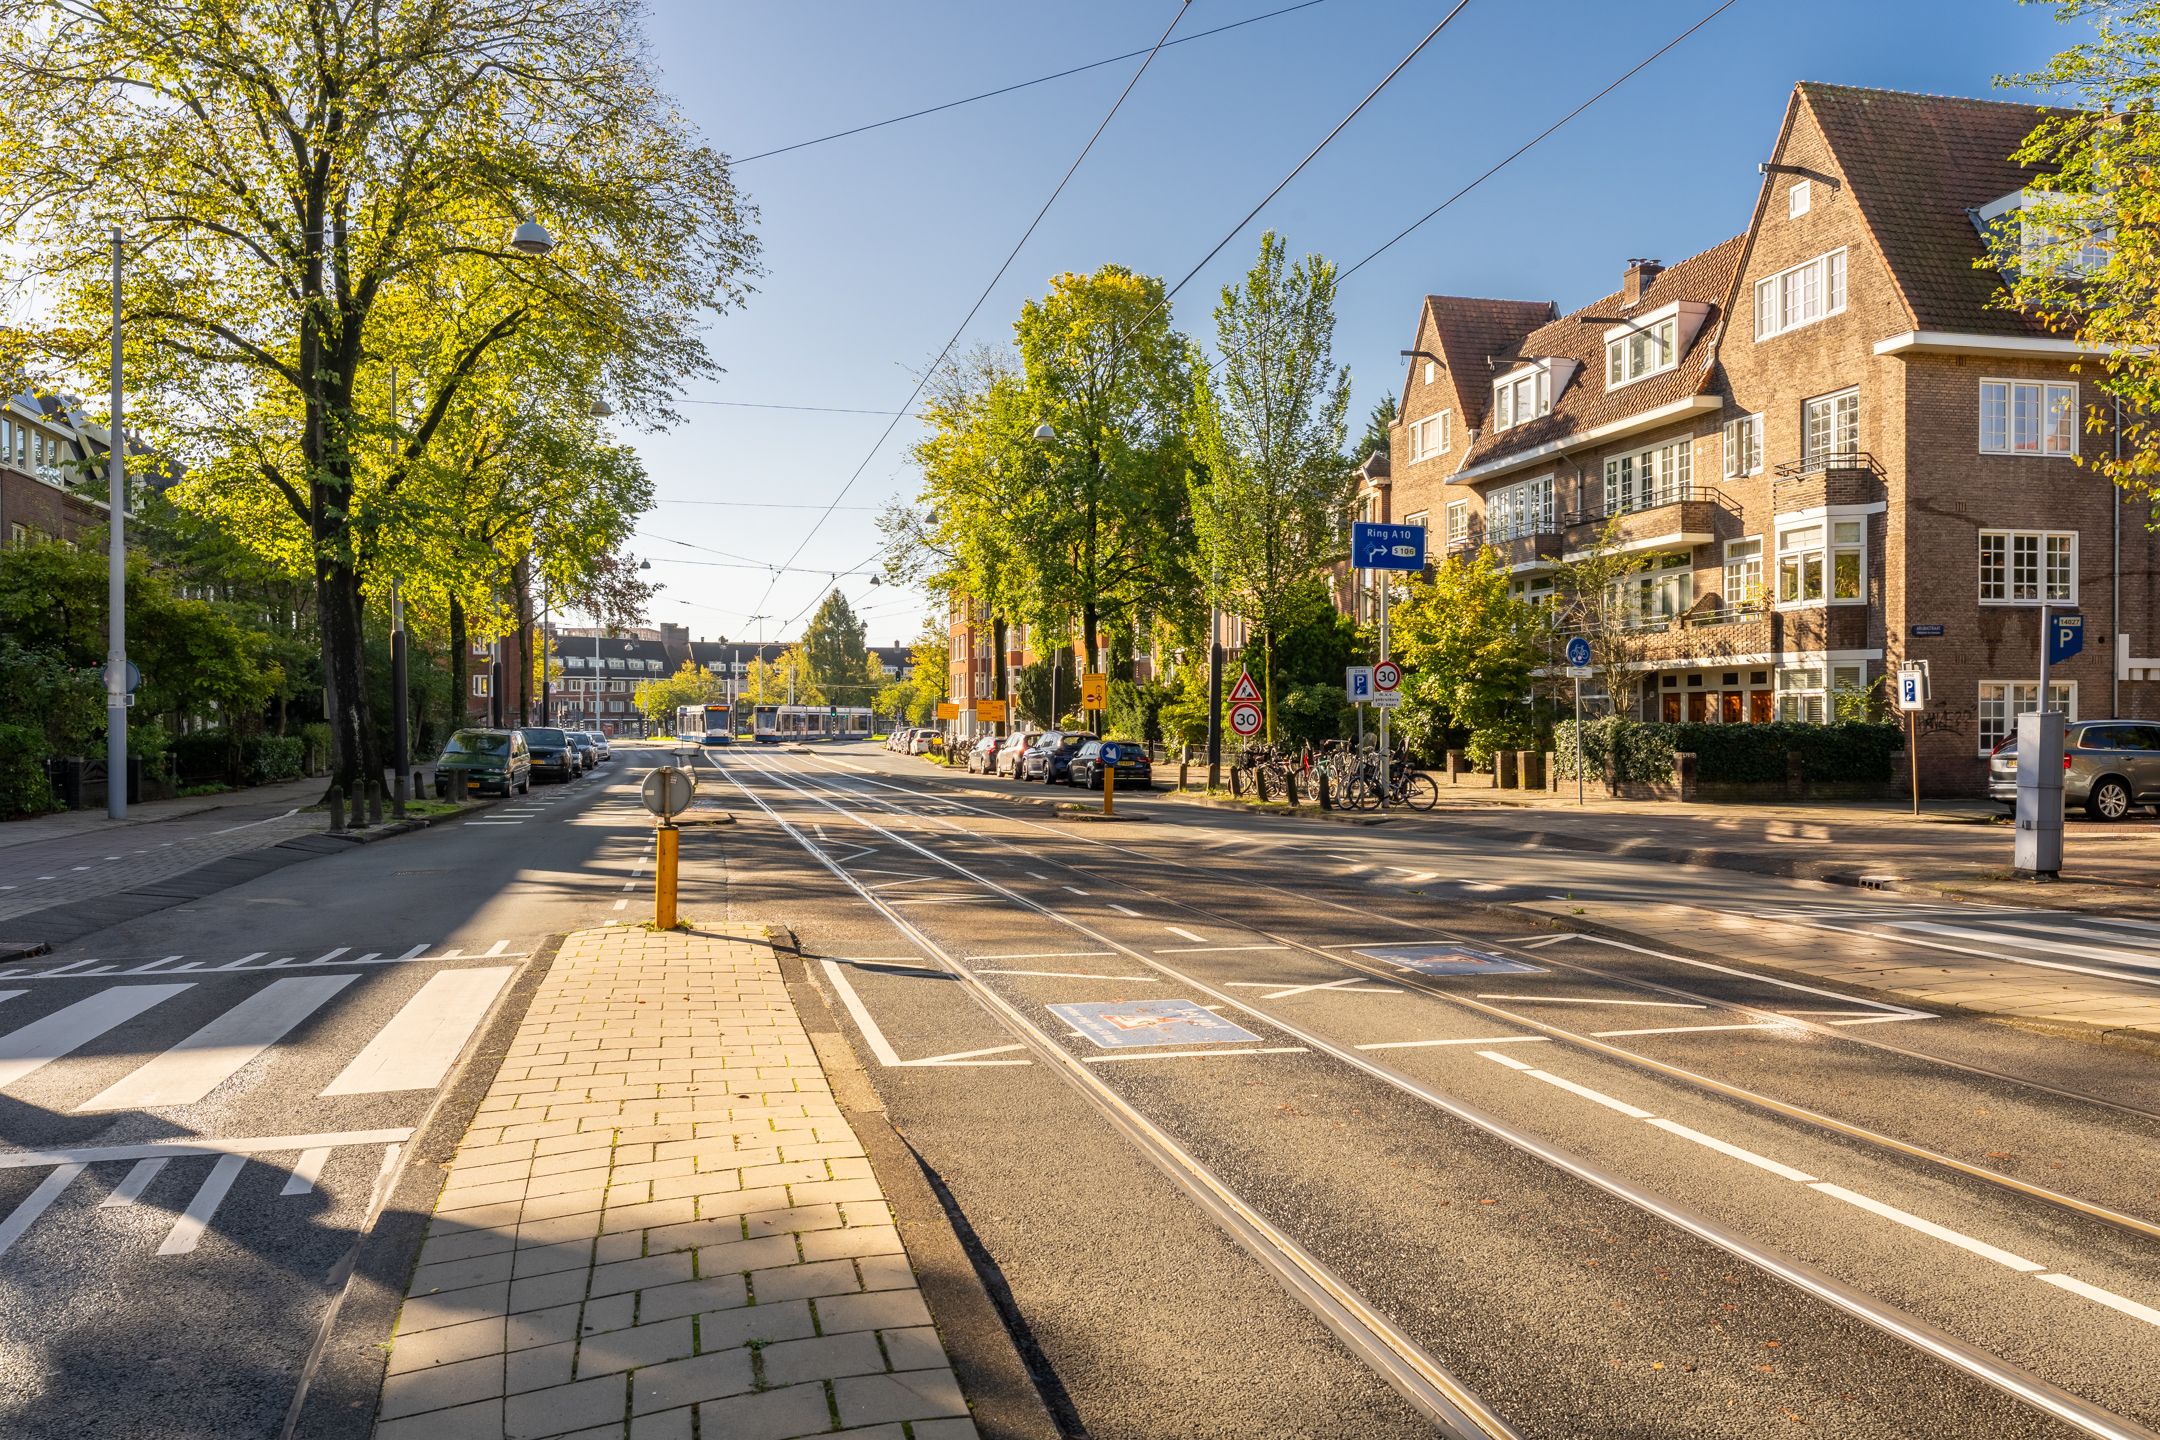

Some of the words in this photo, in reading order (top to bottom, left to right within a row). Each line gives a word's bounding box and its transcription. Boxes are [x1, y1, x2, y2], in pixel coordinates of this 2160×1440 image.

[1367, 528, 1388, 540] Ring
[2060, 628, 2073, 648] P
[1357, 676, 1364, 687] P
[1378, 671, 1396, 682] 30
[1906, 681, 1913, 692] P
[1236, 713, 1257, 726] 30
